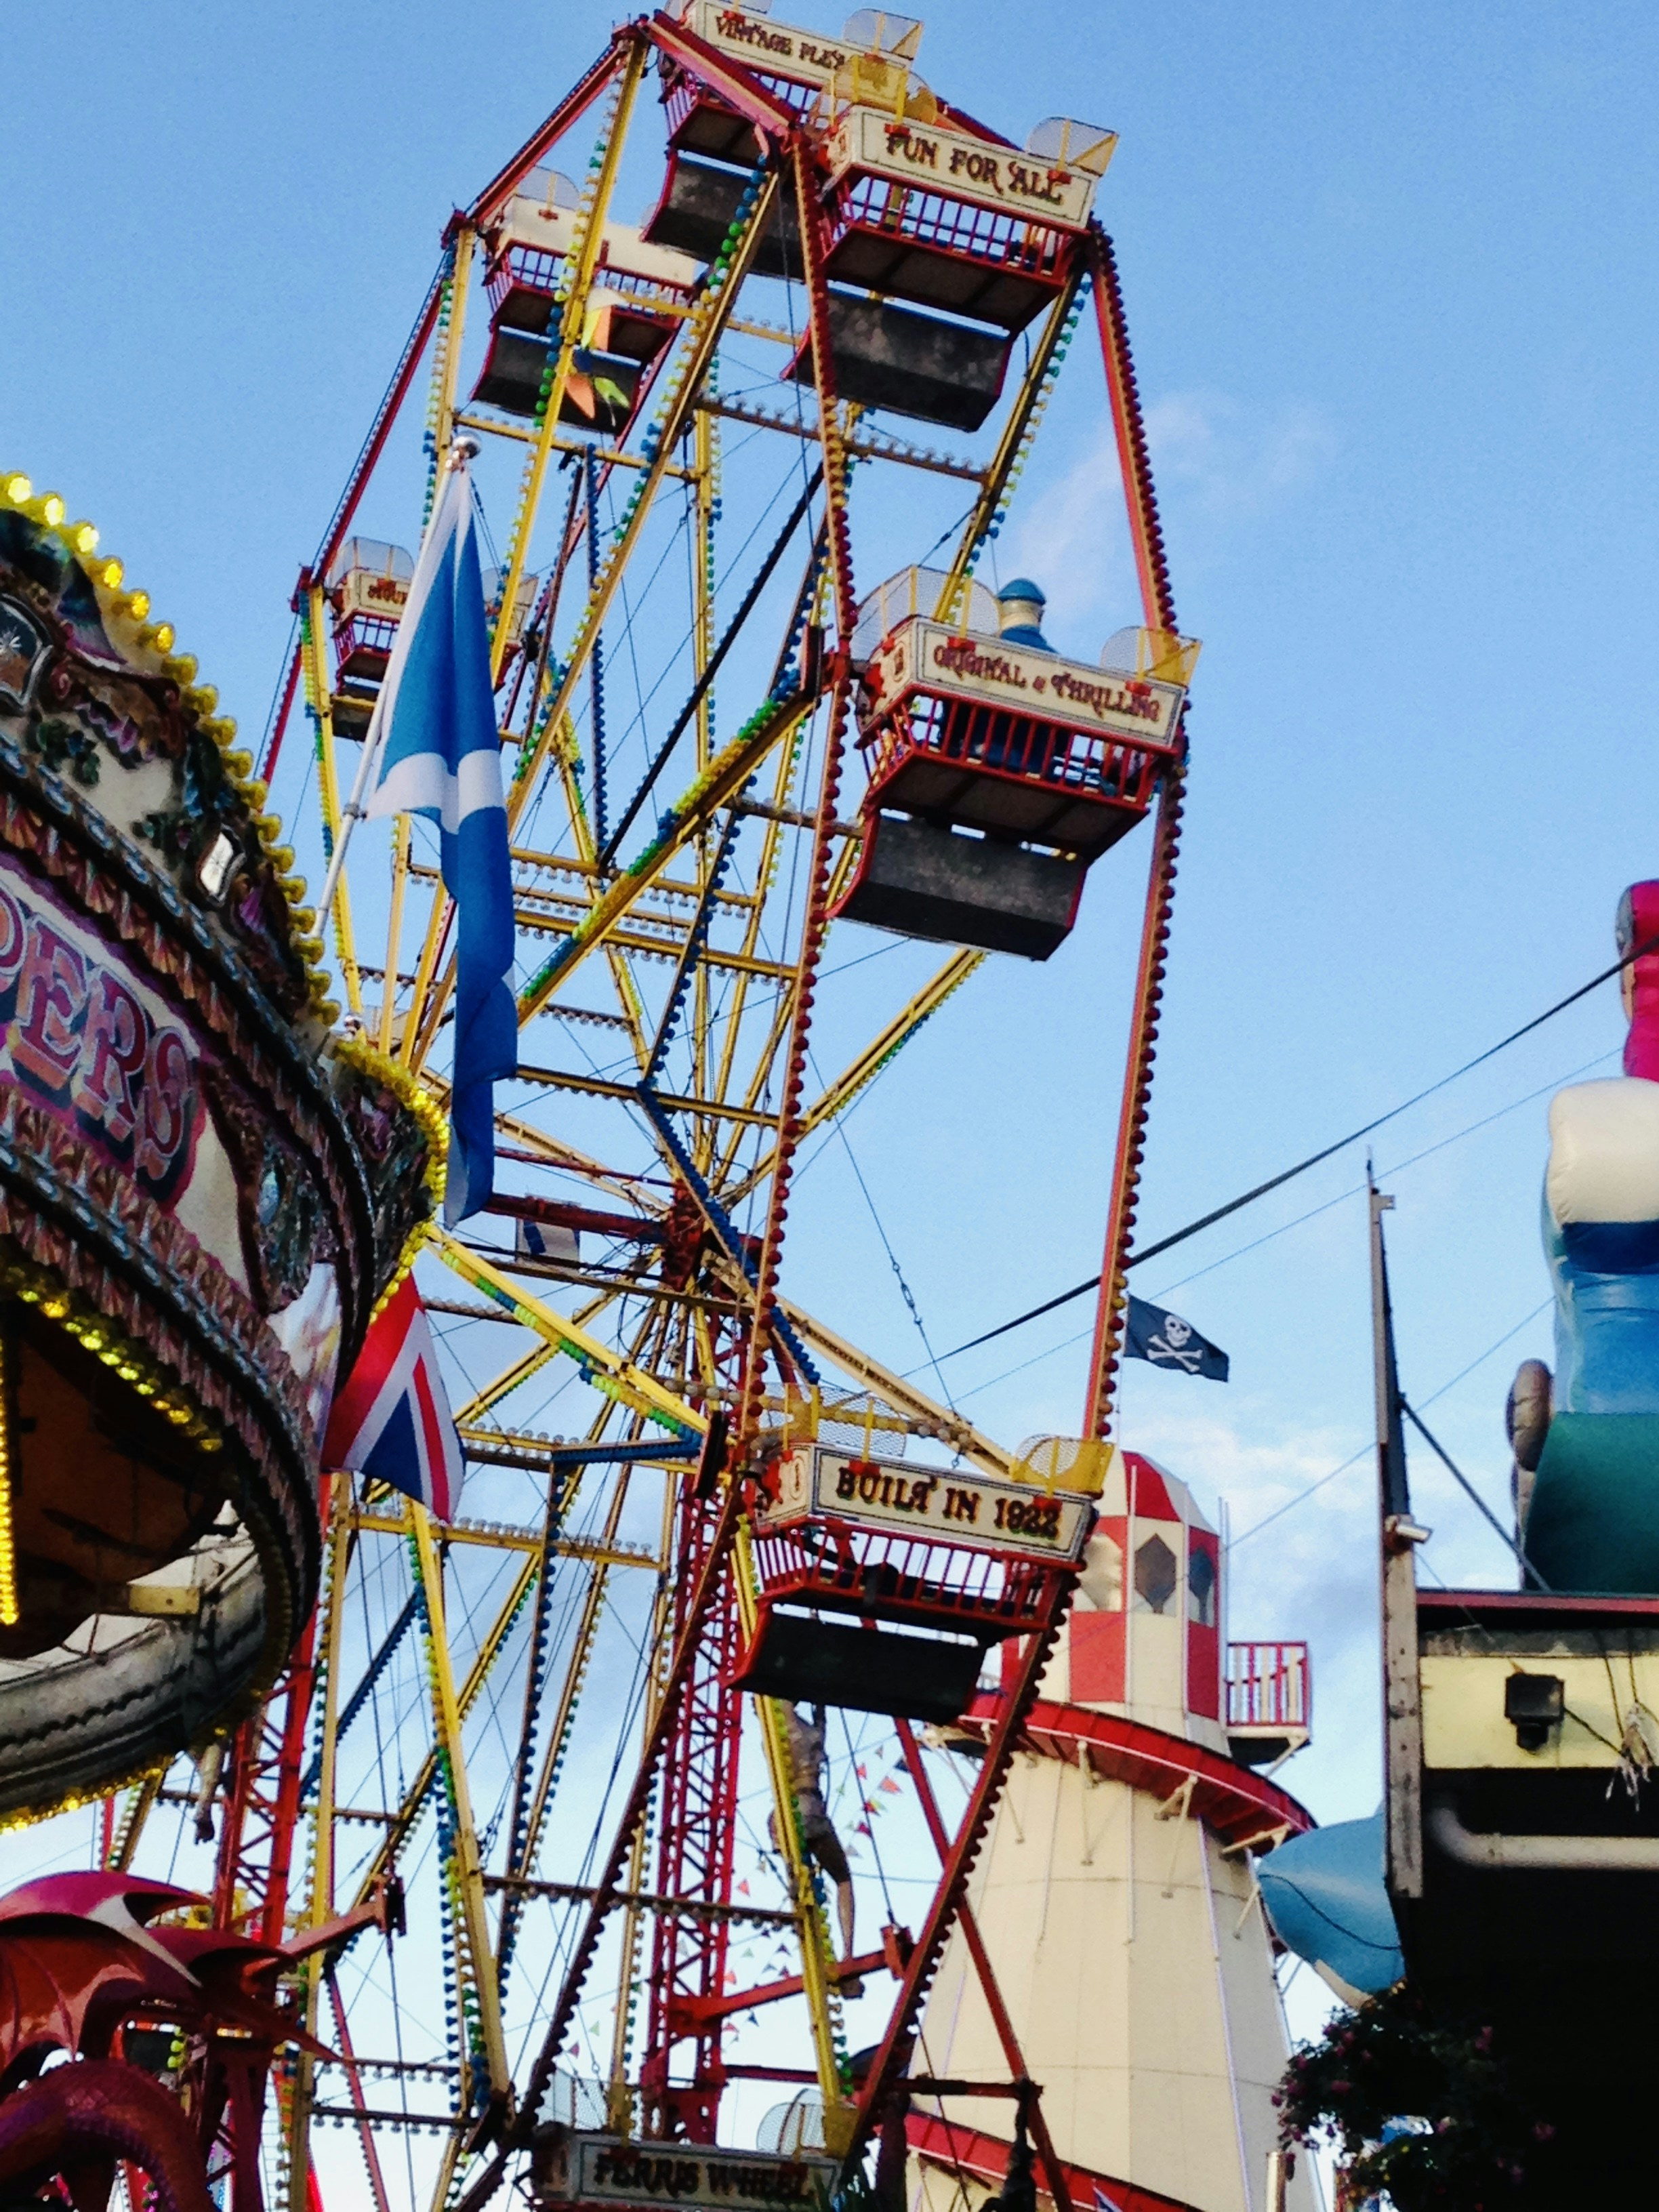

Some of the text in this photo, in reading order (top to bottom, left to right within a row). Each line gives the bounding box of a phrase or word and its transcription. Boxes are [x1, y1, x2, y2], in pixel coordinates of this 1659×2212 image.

[886, 133, 938, 169] FUN
[949, 147, 1004, 196] FOR
[1007, 160, 1063, 205] ALL
[933, 644, 1027, 689] ORIGINAL
[1050, 672, 1161, 722] THRILLING
[836, 1466, 940, 1514] BUILT
[943, 1487, 982, 1524] IN
[594, 2152, 816, 2203] FERRIS WHEEL
